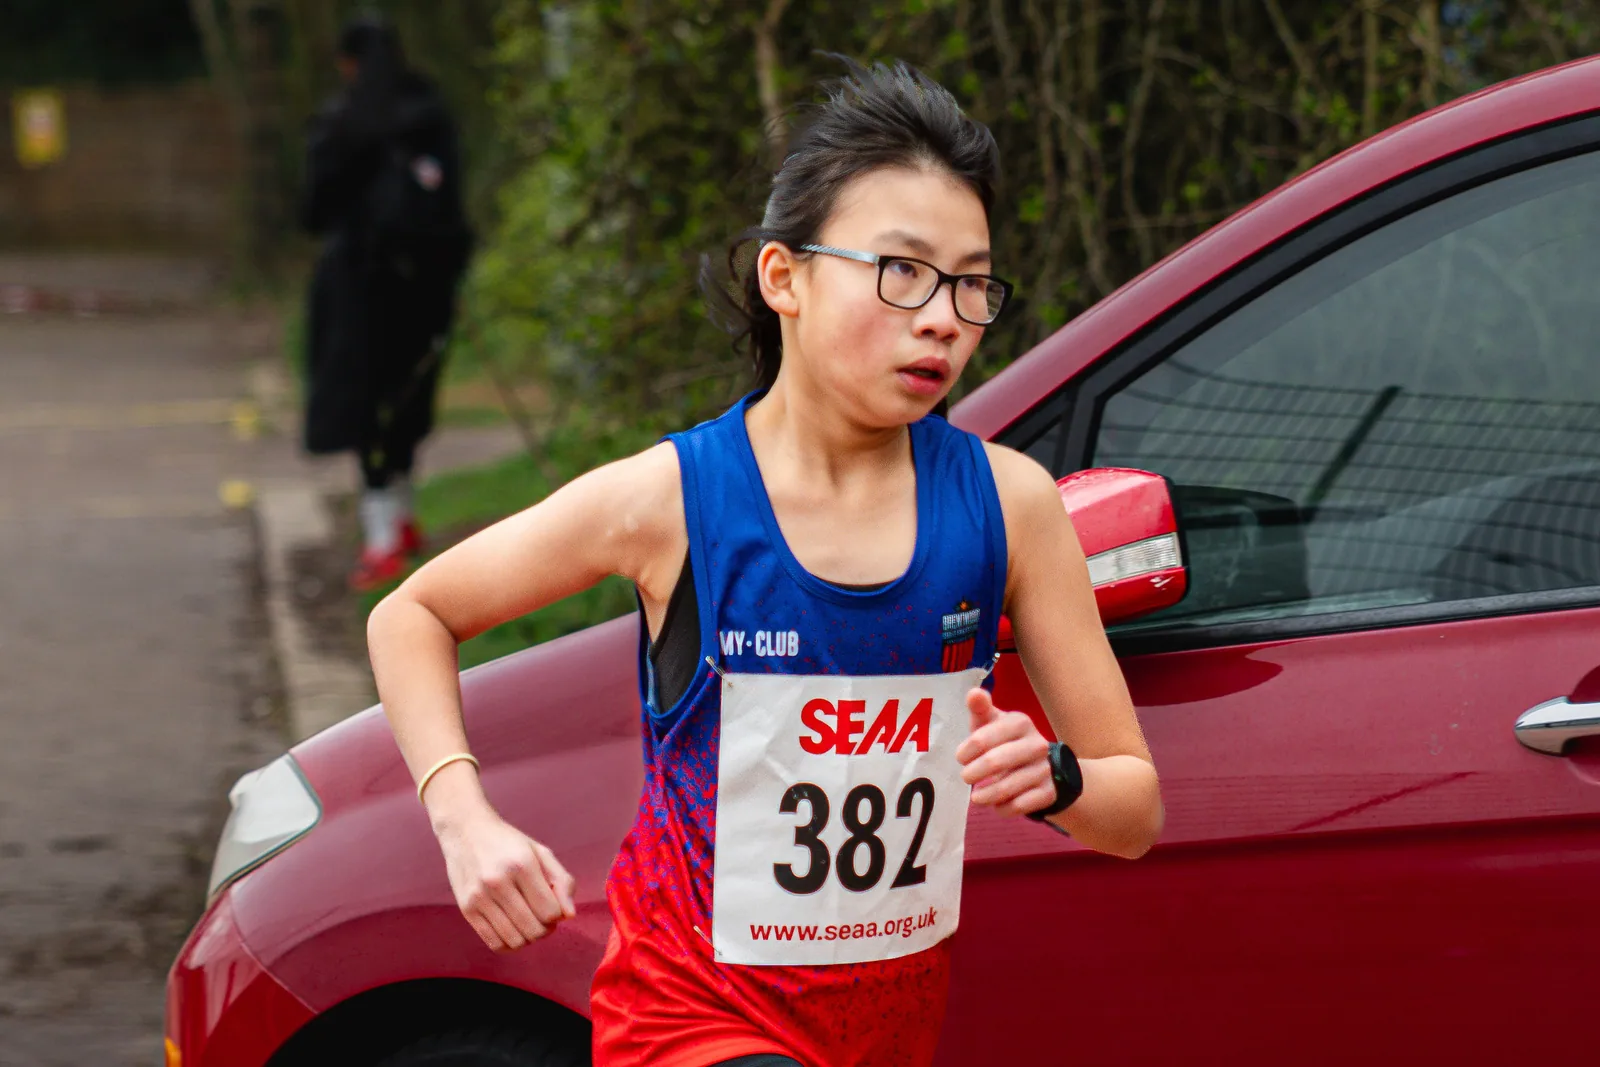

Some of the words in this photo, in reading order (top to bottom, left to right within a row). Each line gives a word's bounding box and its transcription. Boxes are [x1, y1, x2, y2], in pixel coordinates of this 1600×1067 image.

[799, 698, 933, 755] SEAA
[773, 777, 935, 894] 382
[750, 906, 937, 941] www.seaa.org.uk
